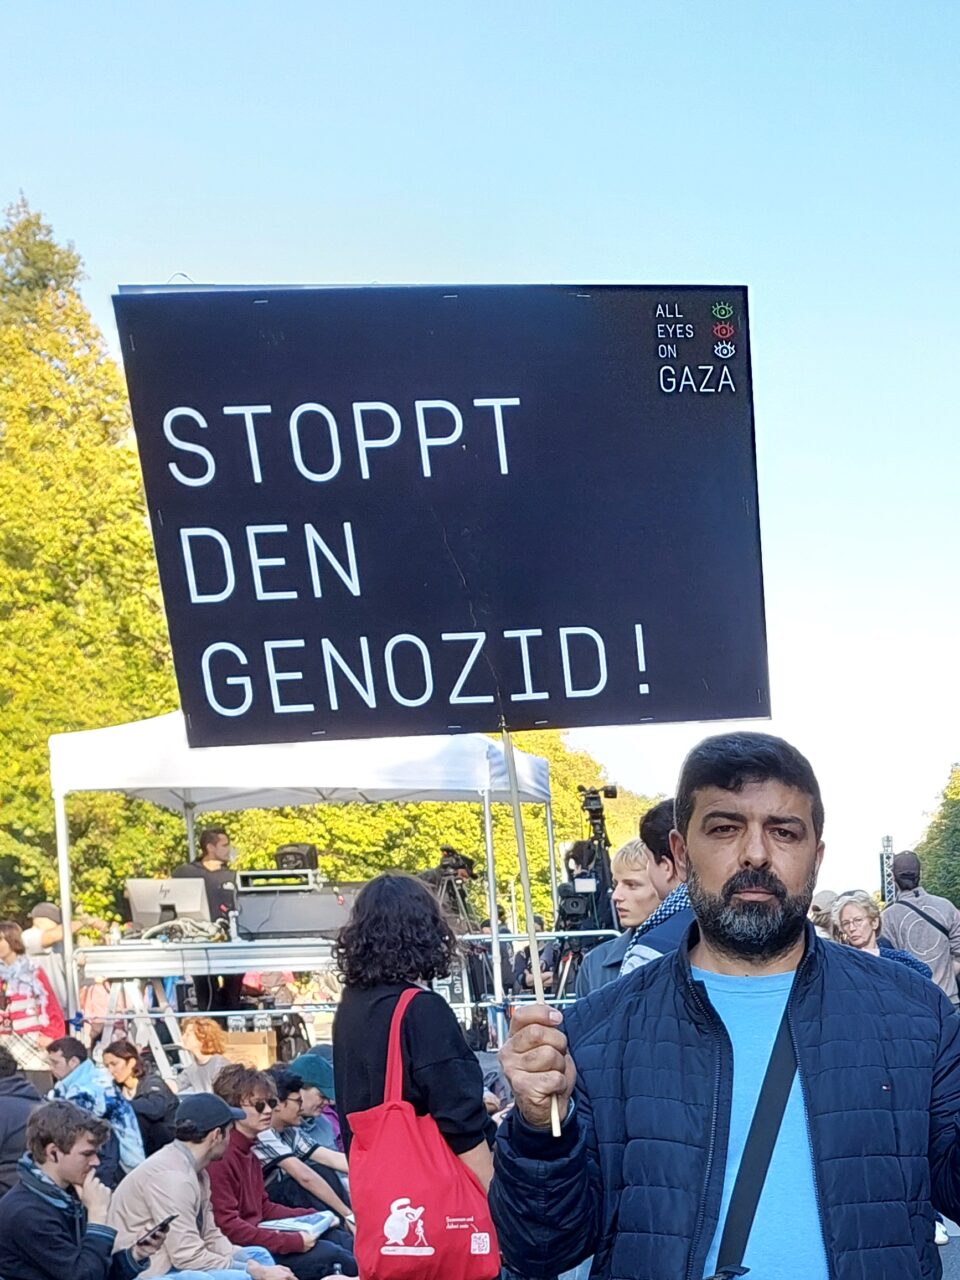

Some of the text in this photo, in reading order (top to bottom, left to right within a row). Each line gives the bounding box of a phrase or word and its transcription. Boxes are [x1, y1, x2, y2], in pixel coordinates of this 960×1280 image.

[655, 303, 684, 318] ALL
[657, 323, 694, 338] EYES
[658, 344, 677, 358] ON
[659, 365, 736, 393] GAZA
[162, 397, 521, 487] STOPPT
[179, 521, 361, 604] DEN
[201, 623, 649, 717] GENOZID!
